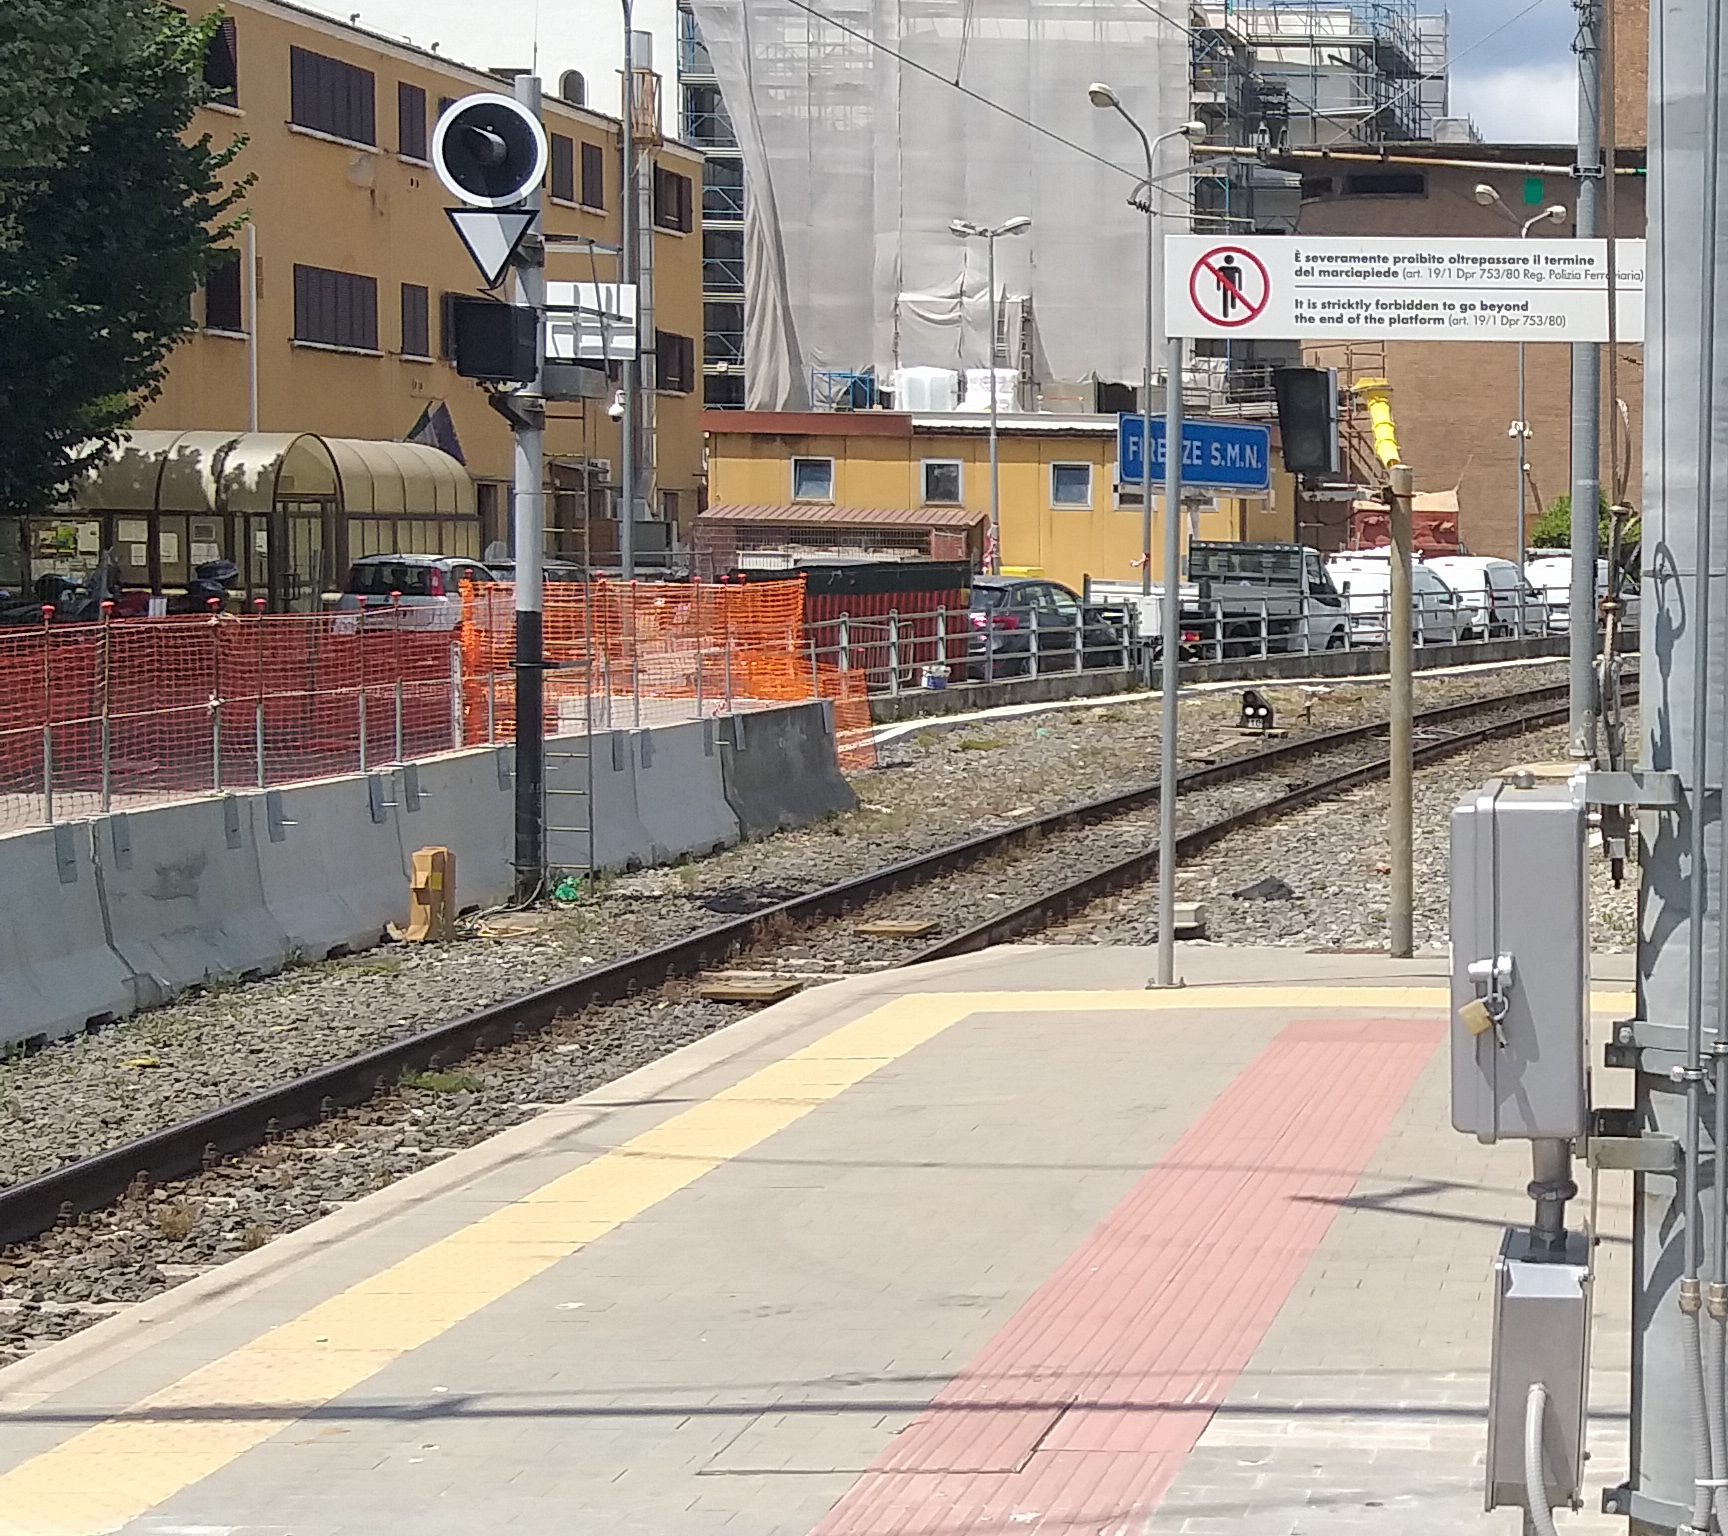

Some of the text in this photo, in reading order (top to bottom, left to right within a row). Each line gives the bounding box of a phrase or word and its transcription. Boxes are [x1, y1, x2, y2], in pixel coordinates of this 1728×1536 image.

[1294, 250, 1595, 267] È severamente proibito oltrepassare il termine
[1294, 266, 1644, 283] del marciapiede (art. 19/1 Dpr 753/80 Reg. Polizia Ferriaria)
[1294, 299, 1529, 314] It is stricktly forbidden to go beyond
[1294, 313, 1566, 328] the end of the platform (art. 19/1 Dpr 753/80)
[1129, 436, 1262, 469] FIREZE S.M.N.
